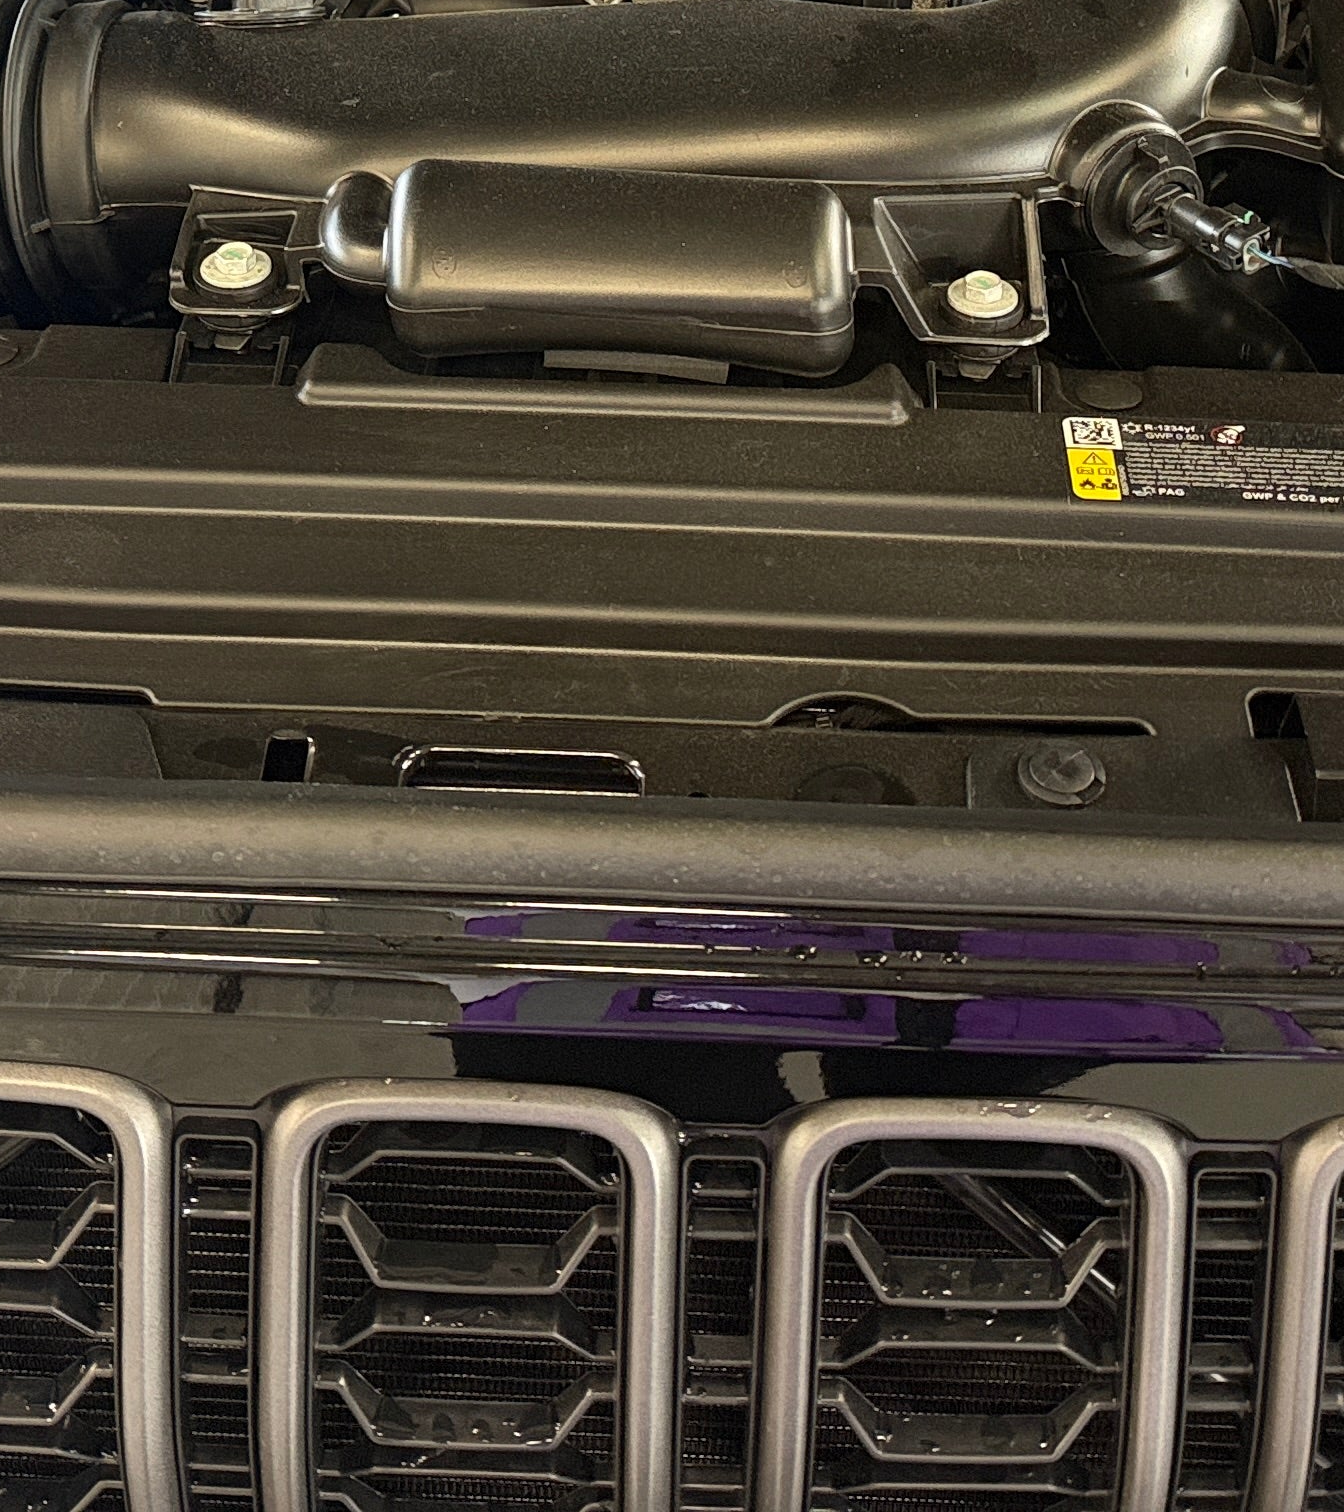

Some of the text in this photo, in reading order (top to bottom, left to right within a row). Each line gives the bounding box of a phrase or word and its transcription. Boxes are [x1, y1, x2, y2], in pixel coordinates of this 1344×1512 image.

[1158, 487, 1186, 497] PAG
[1242, 491, 1274, 501] GWP
[1276, 492, 1287, 501] &
[1288, 493, 1318, 503] CO2
[1319, 495, 1340, 505] per
